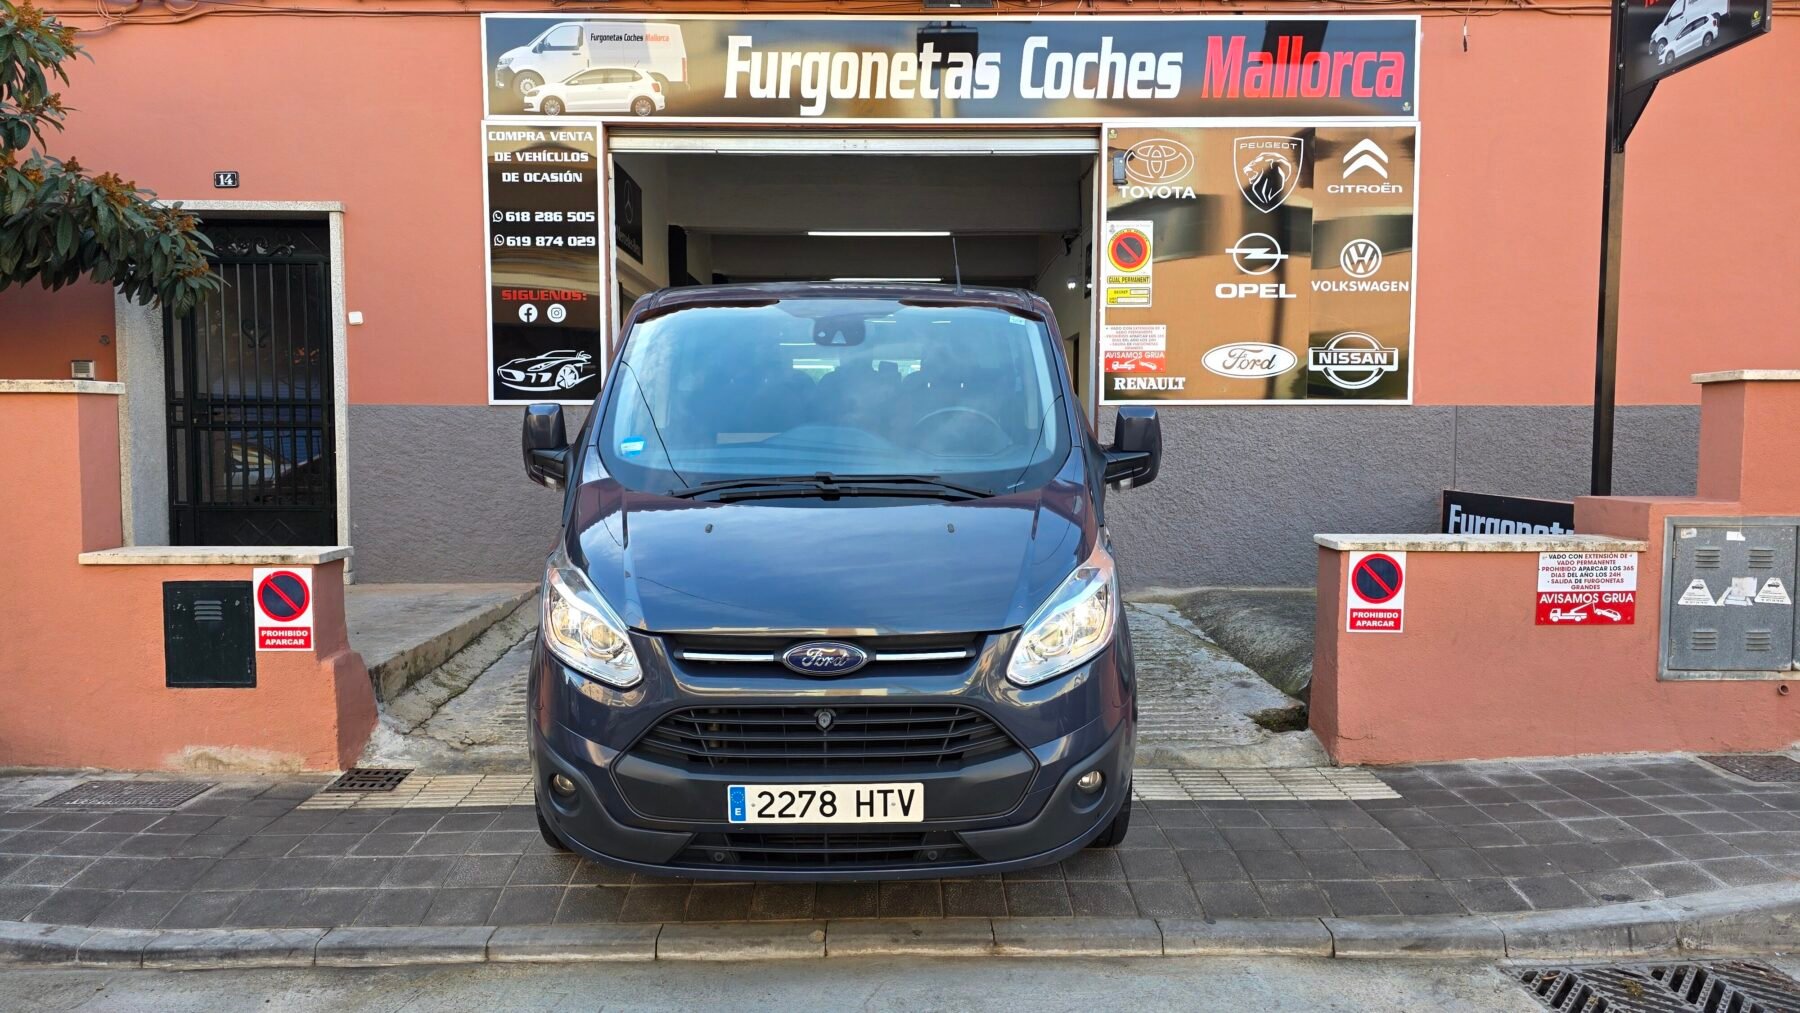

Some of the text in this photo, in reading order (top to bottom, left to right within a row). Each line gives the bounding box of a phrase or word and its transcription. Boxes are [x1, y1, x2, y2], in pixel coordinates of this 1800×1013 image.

[591, 33, 622, 43] Furgonetas
[624, 33, 643, 42] Coches
[724, 35, 1405, 117] Furgonetas Coches Mallorca
[488, 131, 594, 141] COMPRA VENTA
[1240, 142, 1297, 150] PEUGEOT
[494, 150, 589, 162] DE VEHÍCULOS
[219, 174, 233, 185] 14
[502, 170, 583, 182] DE OCASIÓN
[1118, 186, 1197, 199] TOYOTA
[505, 211, 595, 222] 618 286 505
[506, 236, 596, 247] 619 874 029
[1215, 283, 1297, 299] OPEL
[1311, 279, 1409, 292] VOLKSWAGEN
[1105, 351, 1143, 359] AVISAMOS
[1222, 347, 1276, 371] Ford
[1319, 352, 1388, 365] NISSAN
[1113, 376, 1186, 391] RENAULT
[1448, 504, 1574, 535] Furgon
[1540, 593, 1634, 604] AVISAMOS GRUA
[801, 647, 849, 667] Ford
[757, 789, 915, 818] 2278 HTV
[735, 808, 741, 816] E
